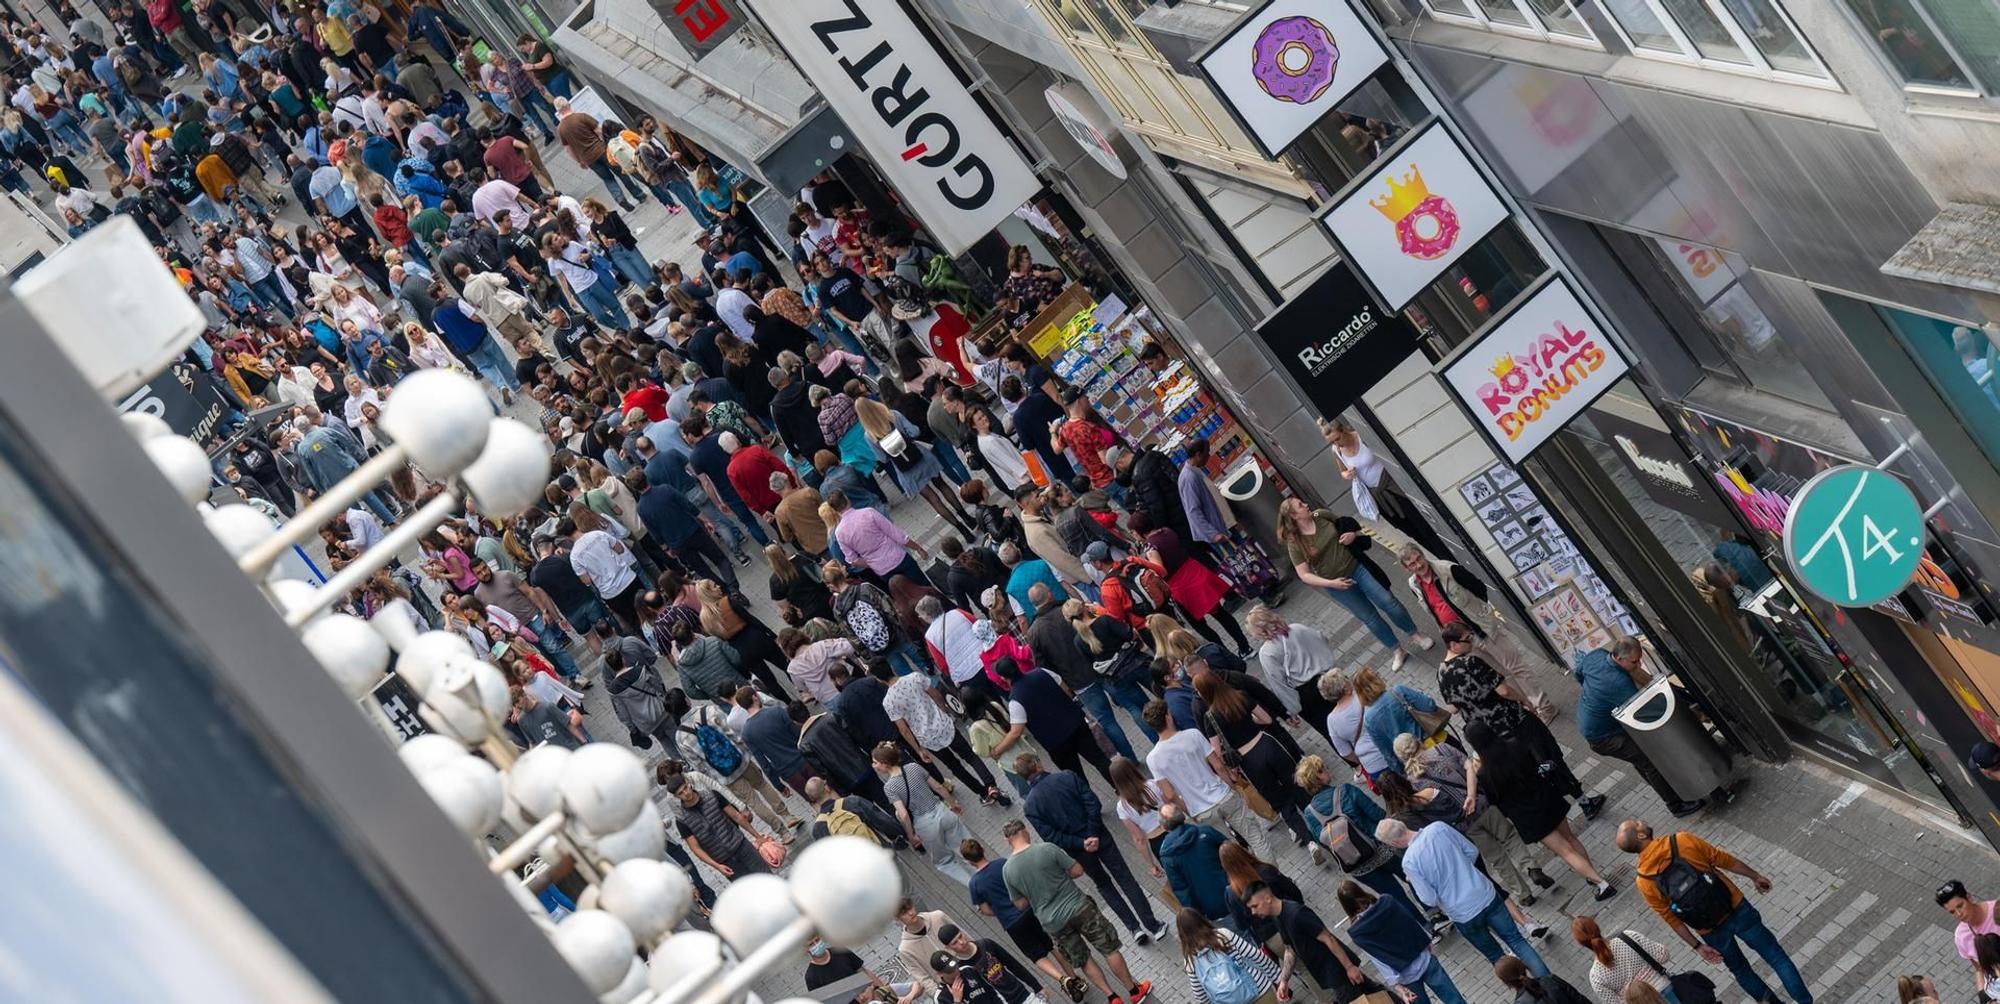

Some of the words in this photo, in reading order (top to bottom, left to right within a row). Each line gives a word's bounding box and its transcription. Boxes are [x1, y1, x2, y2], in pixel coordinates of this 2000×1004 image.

[810, 0, 995, 211] GÖRTZ
[1298, 311, 1371, 370] Riccardo
[1476, 320, 1587, 415] ROYAL
[1497, 341, 1605, 442] DONUTS
